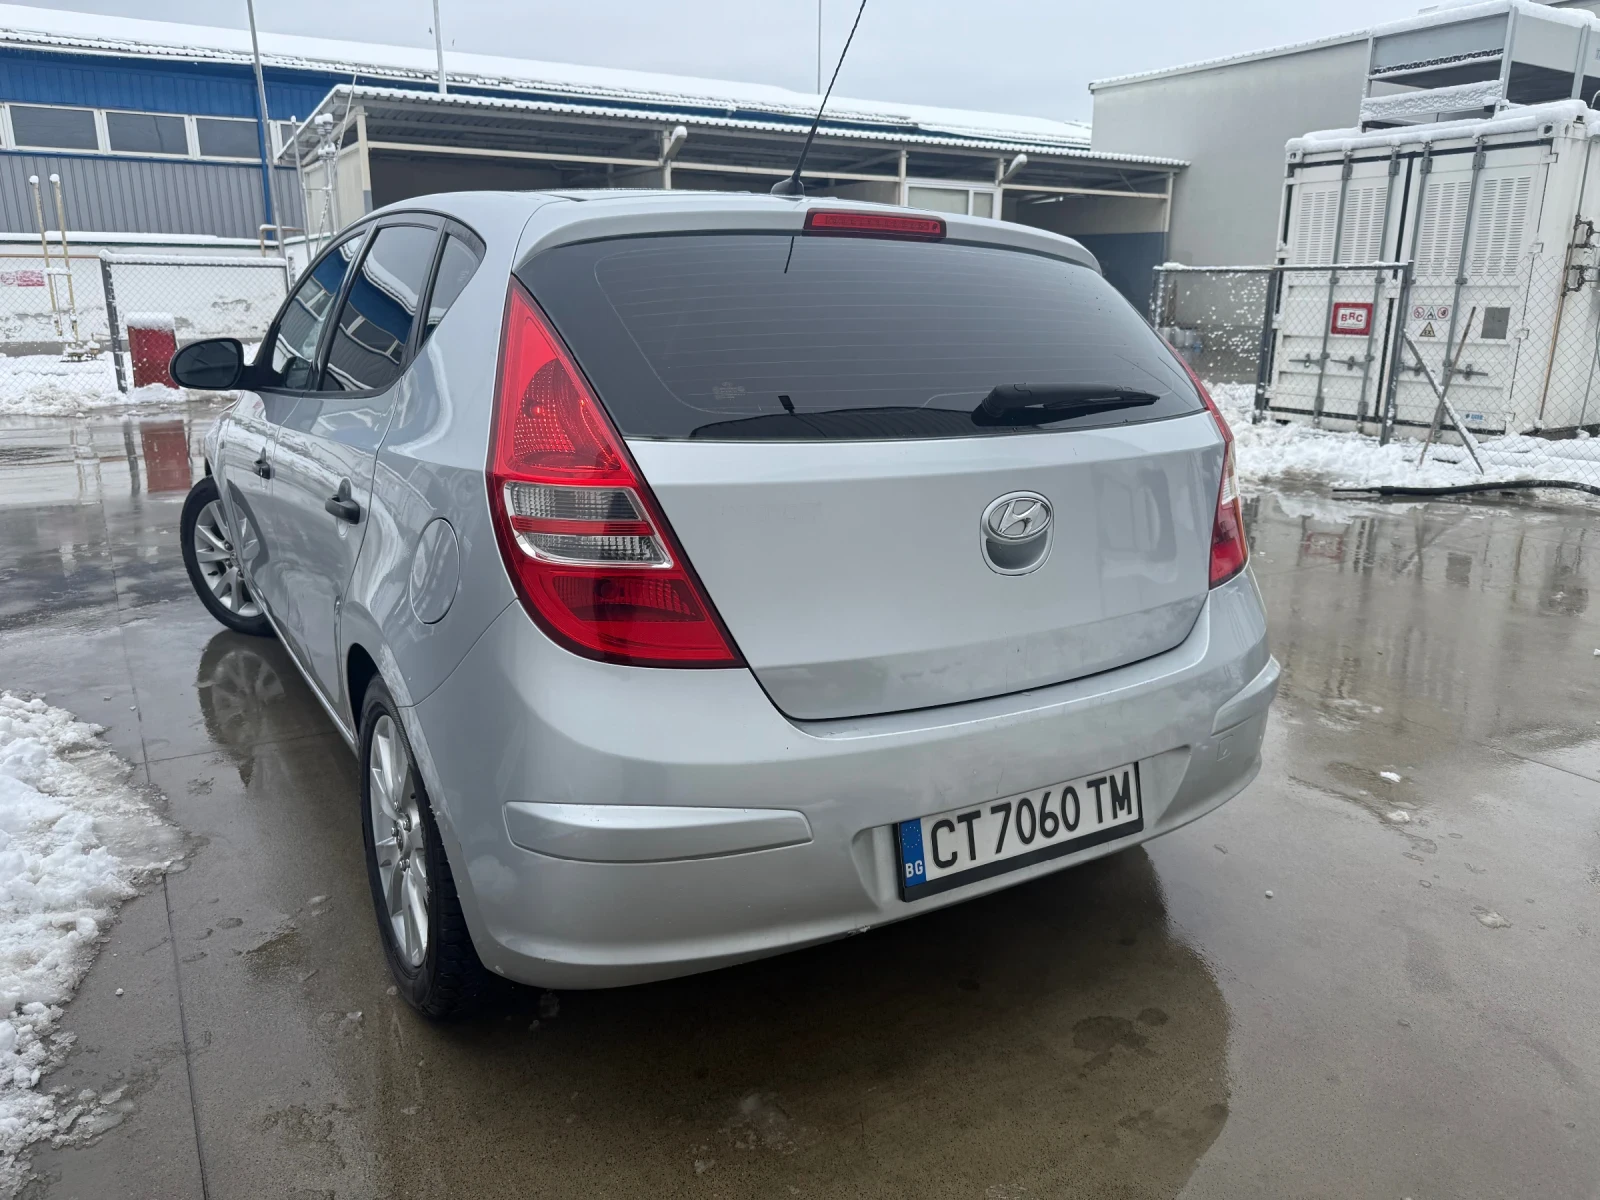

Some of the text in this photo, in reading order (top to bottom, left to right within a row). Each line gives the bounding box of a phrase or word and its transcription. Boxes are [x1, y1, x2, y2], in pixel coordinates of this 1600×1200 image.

[1341, 312, 1364, 322] BRC
[930, 770, 1133, 869] CT 7060 TM
[905, 860, 924, 878] BG
